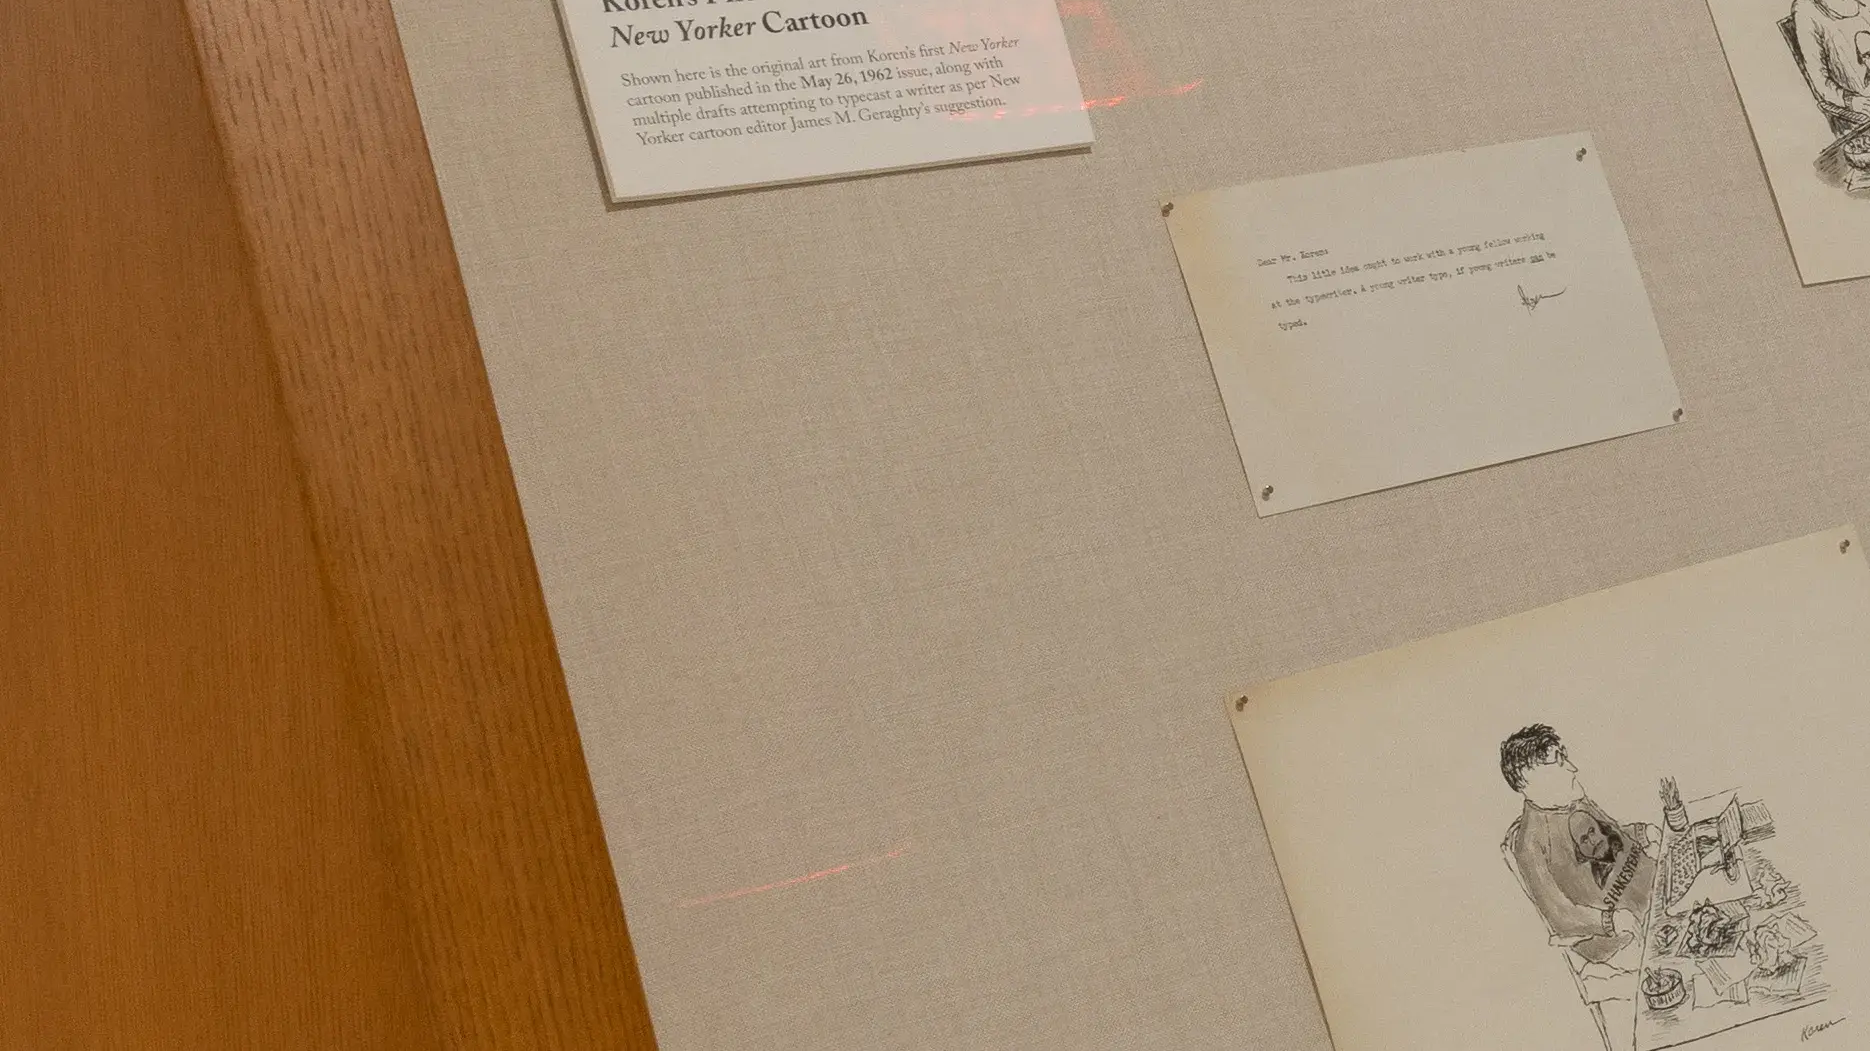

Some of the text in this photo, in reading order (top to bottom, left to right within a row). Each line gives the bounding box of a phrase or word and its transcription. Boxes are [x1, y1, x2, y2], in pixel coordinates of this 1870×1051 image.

[611, 9, 869, 48] New Yorker Cartoon
[620, 36, 1020, 87] Shown here is the original art from Koren's first New Yorker
[627, 56, 1004, 107] cartoon published in the May 26, 1962 issue, along with
[633, 73, 1021, 127] multiple drafts attempting to typecast a writer as per New
[636, 97, 1007, 147] Yorker cartoon editor James M. Geraghty's suggestion.
[1280, 254, 1297, 262] Mr.
[1287, 274, 1308, 283] This
[1391, 257, 1401, 265] to
[1427, 249, 1447, 259] with
[1484, 238, 1511, 249] fellow
[1514, 232, 1546, 244] working
[1285, 298, 1301, 306] the
[1397, 276, 1426, 285] writer
[1456, 266, 1465, 276] if
